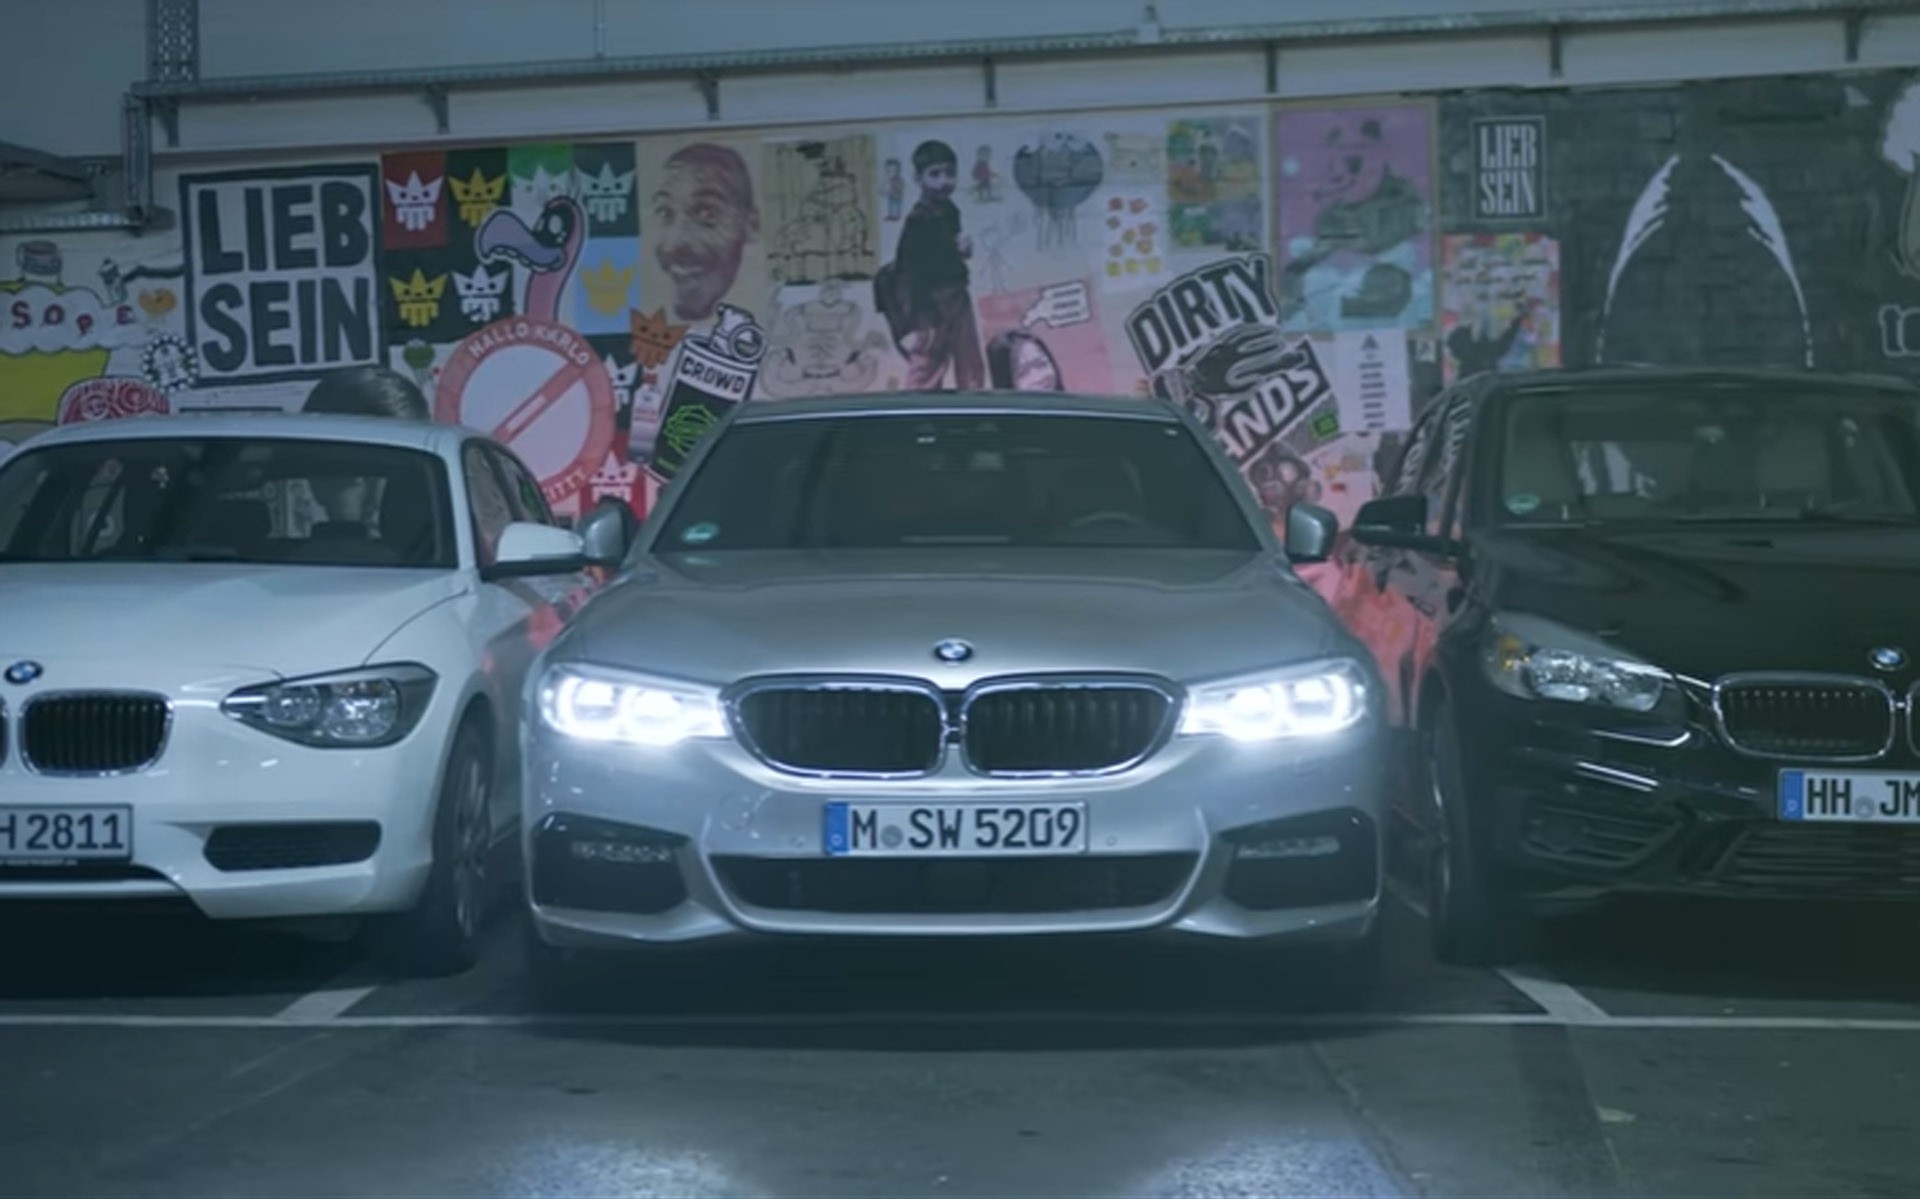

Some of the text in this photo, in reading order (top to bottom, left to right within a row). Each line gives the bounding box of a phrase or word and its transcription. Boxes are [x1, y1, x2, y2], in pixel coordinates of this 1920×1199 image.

[1480, 124, 1537, 169] LIEB
[1480, 170, 1536, 214] SEIN
[198, 181, 369, 275] LIEB
[201, 277, 373, 373] SEIN
[1131, 259, 1277, 372] DIRTY
[469, 322, 591, 365] HALLO KARLO
[681, 357, 746, 393] CROWD
[1808, 778, 1920, 816] HH JM
[26, 813, 124, 850] 2811
[851, 807, 1080, 849] M SW 5209
